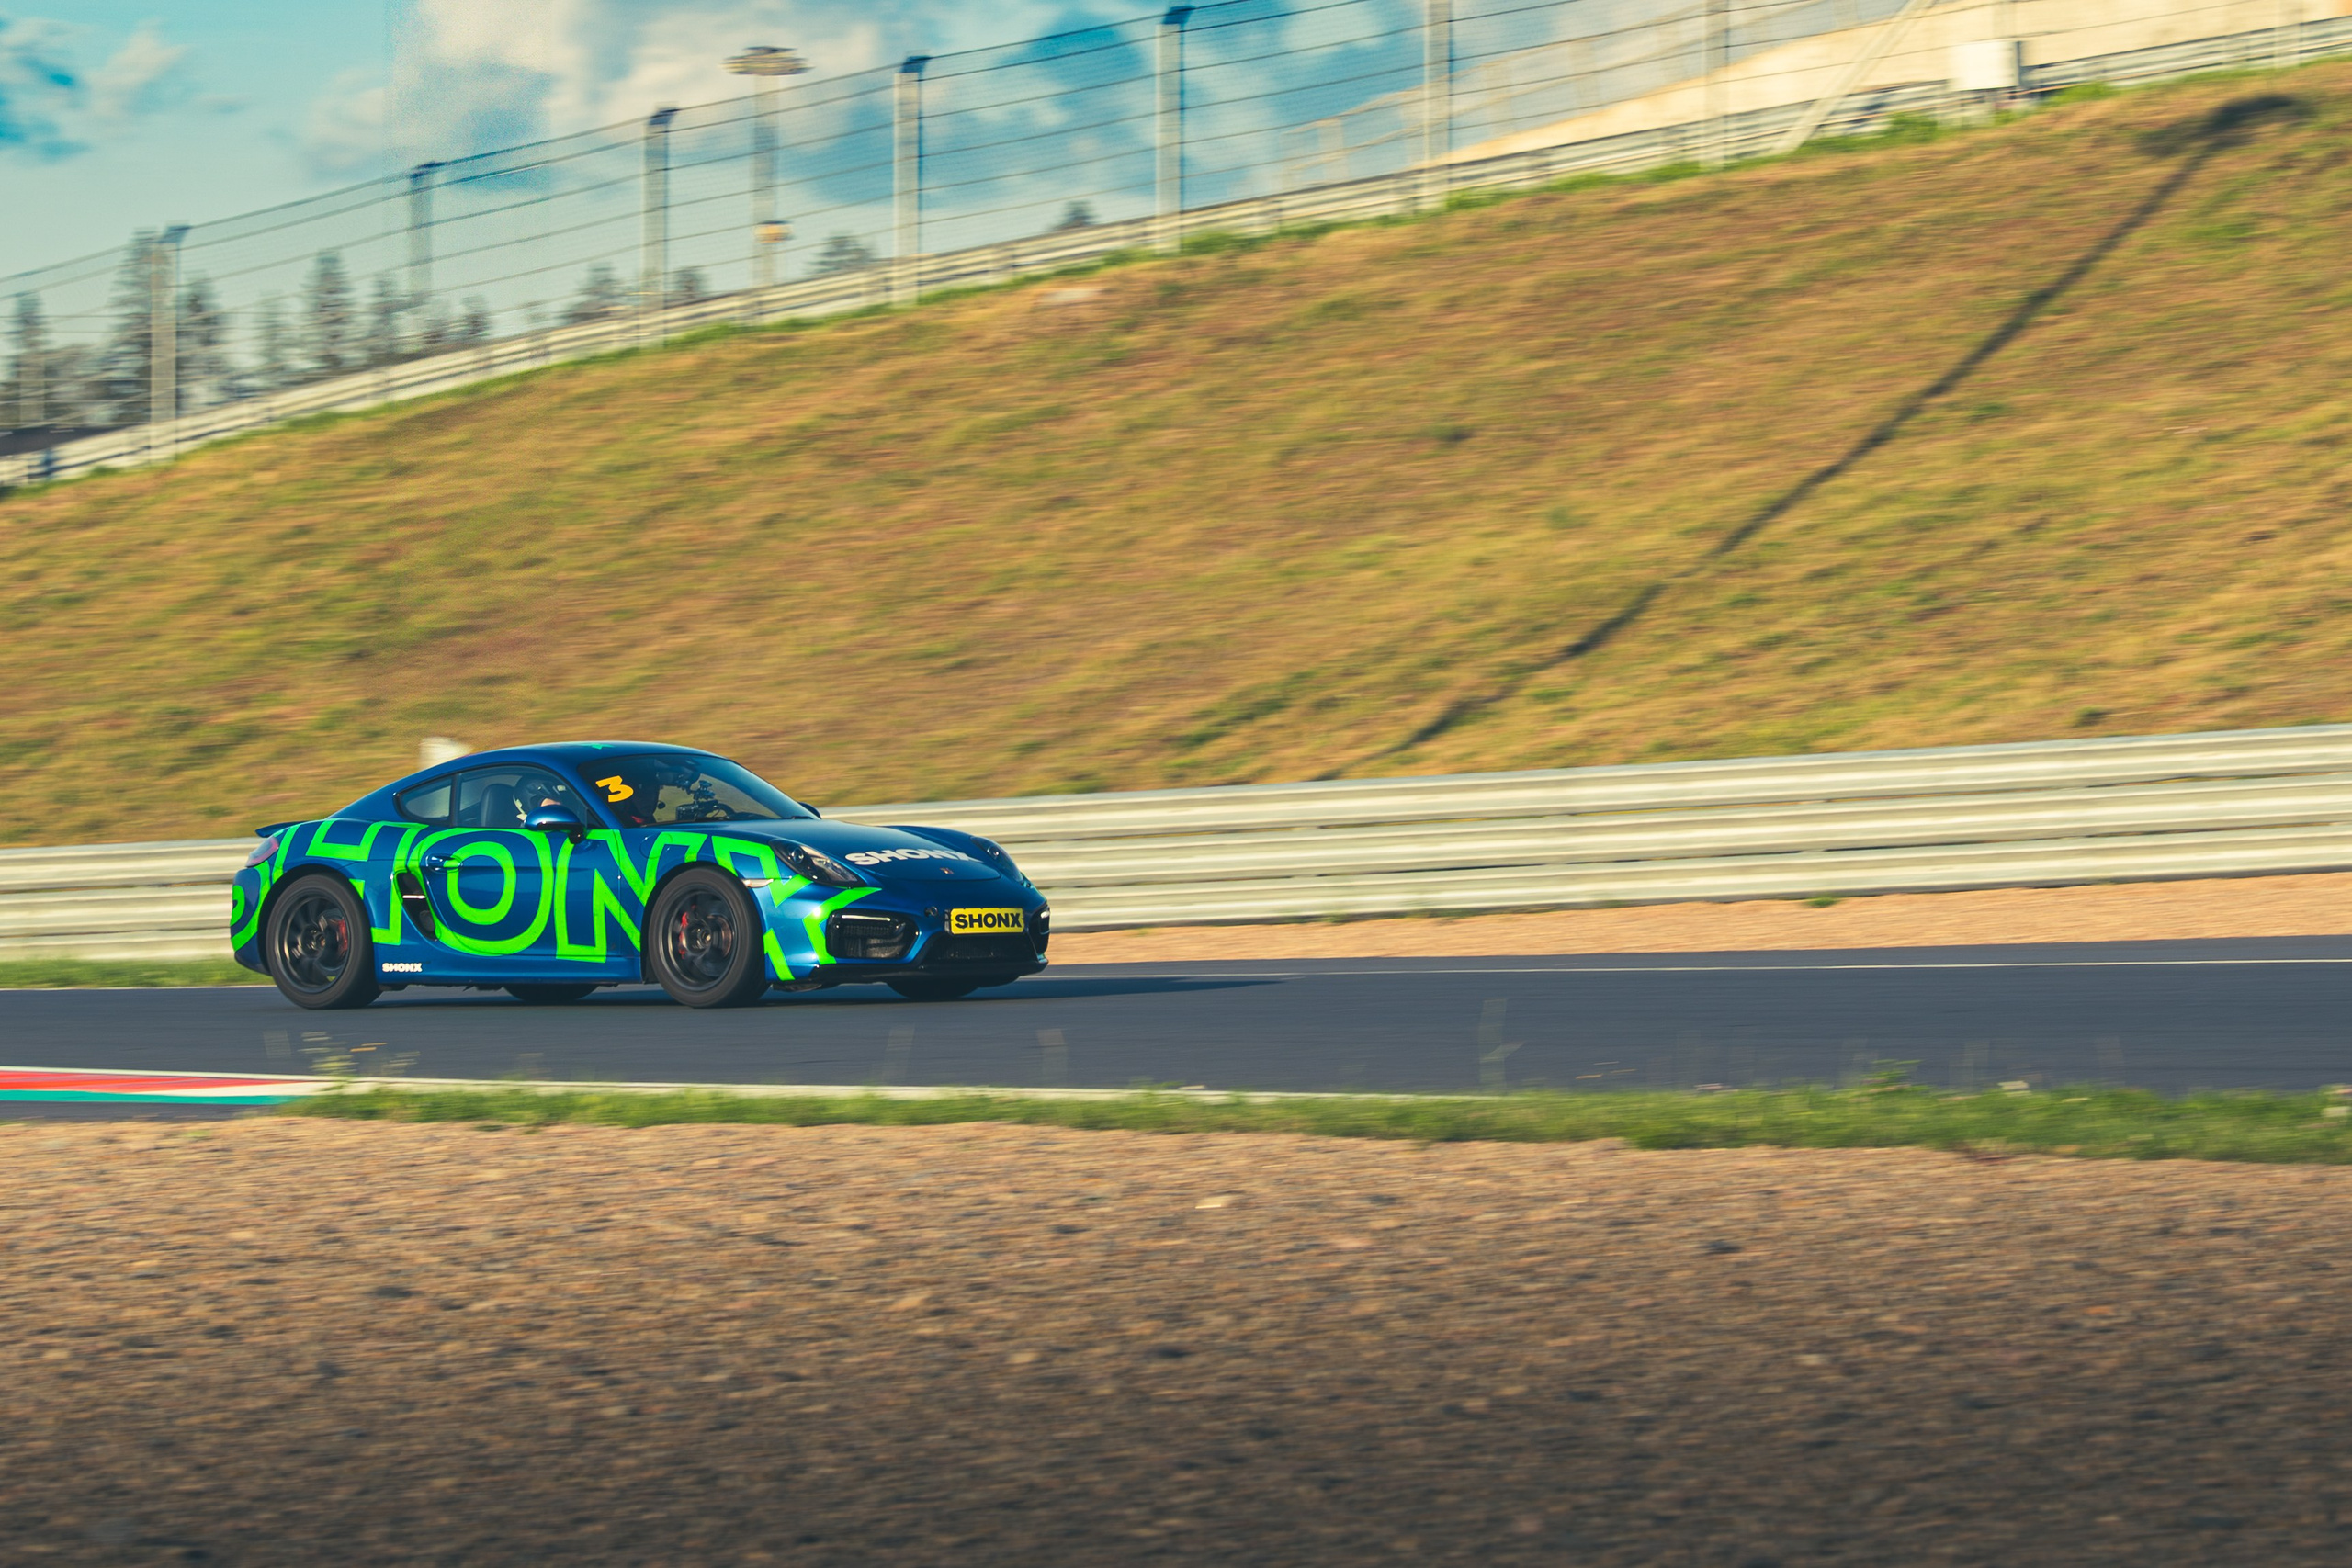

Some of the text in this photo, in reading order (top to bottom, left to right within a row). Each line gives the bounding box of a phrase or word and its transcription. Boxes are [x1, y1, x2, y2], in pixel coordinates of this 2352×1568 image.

[595, 775, 634, 803] 3
[844, 848, 985, 866] SHONX
[956, 912, 1022, 929] SHONX
[381, 962, 423, 973] SHONX
